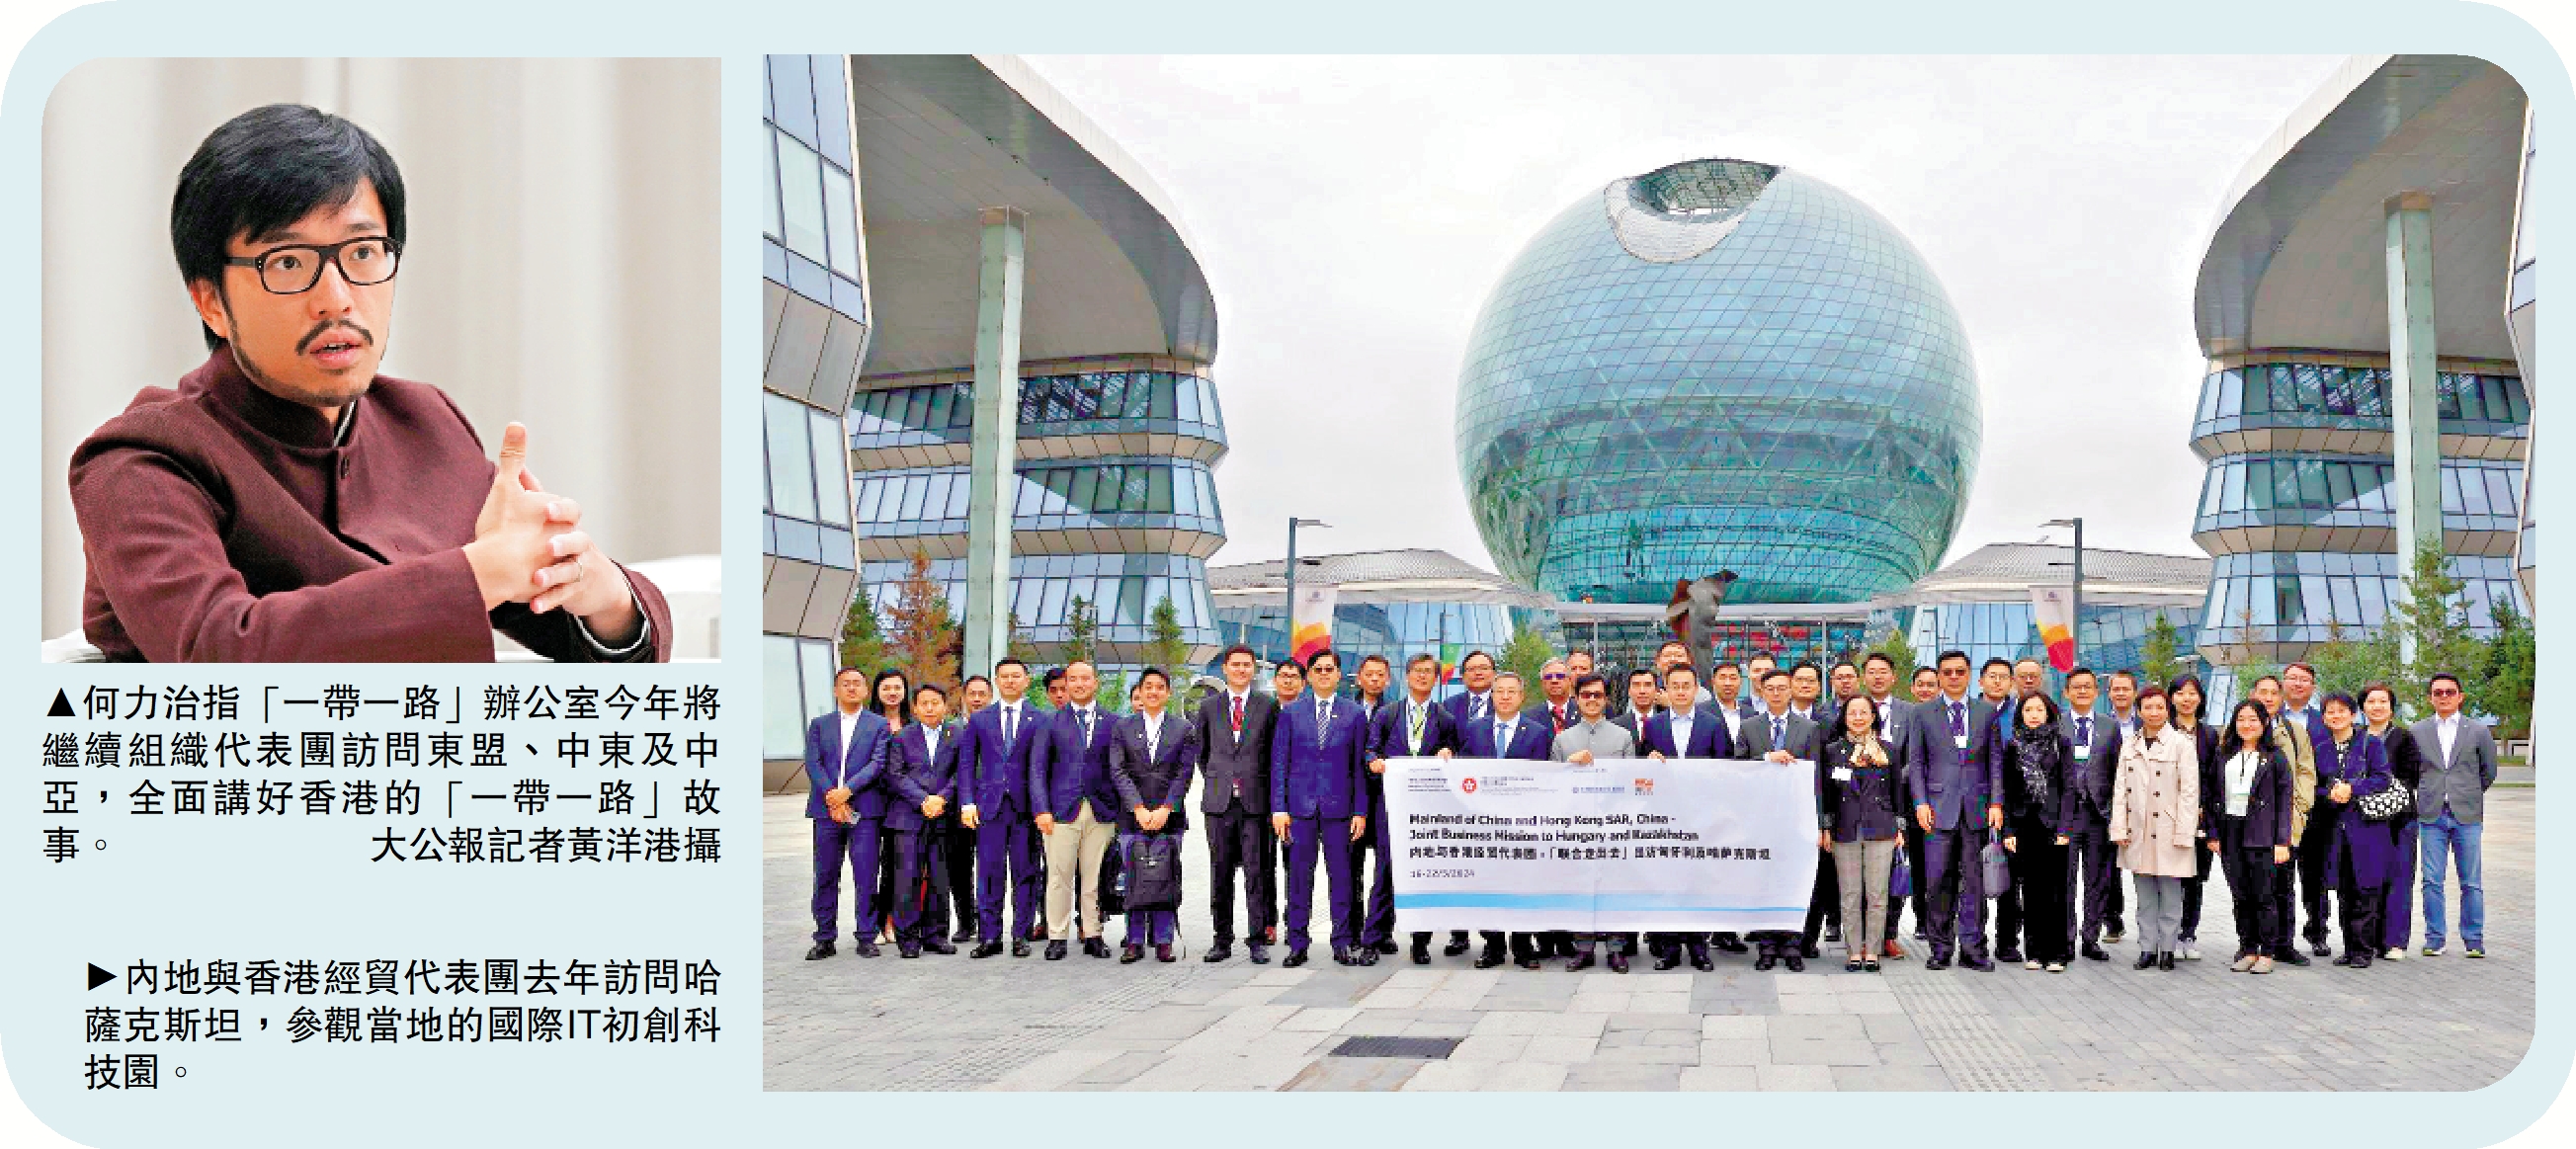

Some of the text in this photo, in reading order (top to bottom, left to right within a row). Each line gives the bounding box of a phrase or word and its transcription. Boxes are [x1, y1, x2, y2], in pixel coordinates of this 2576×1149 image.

[1409, 813, 1462, 825] Mainland
[1464, 813, 1476, 825] of
[1478, 814, 1513, 826] China
[1515, 814, 1537, 826] and
[1540, 815, 1572, 828] Hong
[1575, 815, 1605, 828] Kong
[1606, 814, 1633, 826] SAR,
[1636, 813, 1669, 825] China
[1409, 828, 1700, 844] Joint Business Mission to Hungary and Kazakhstan
